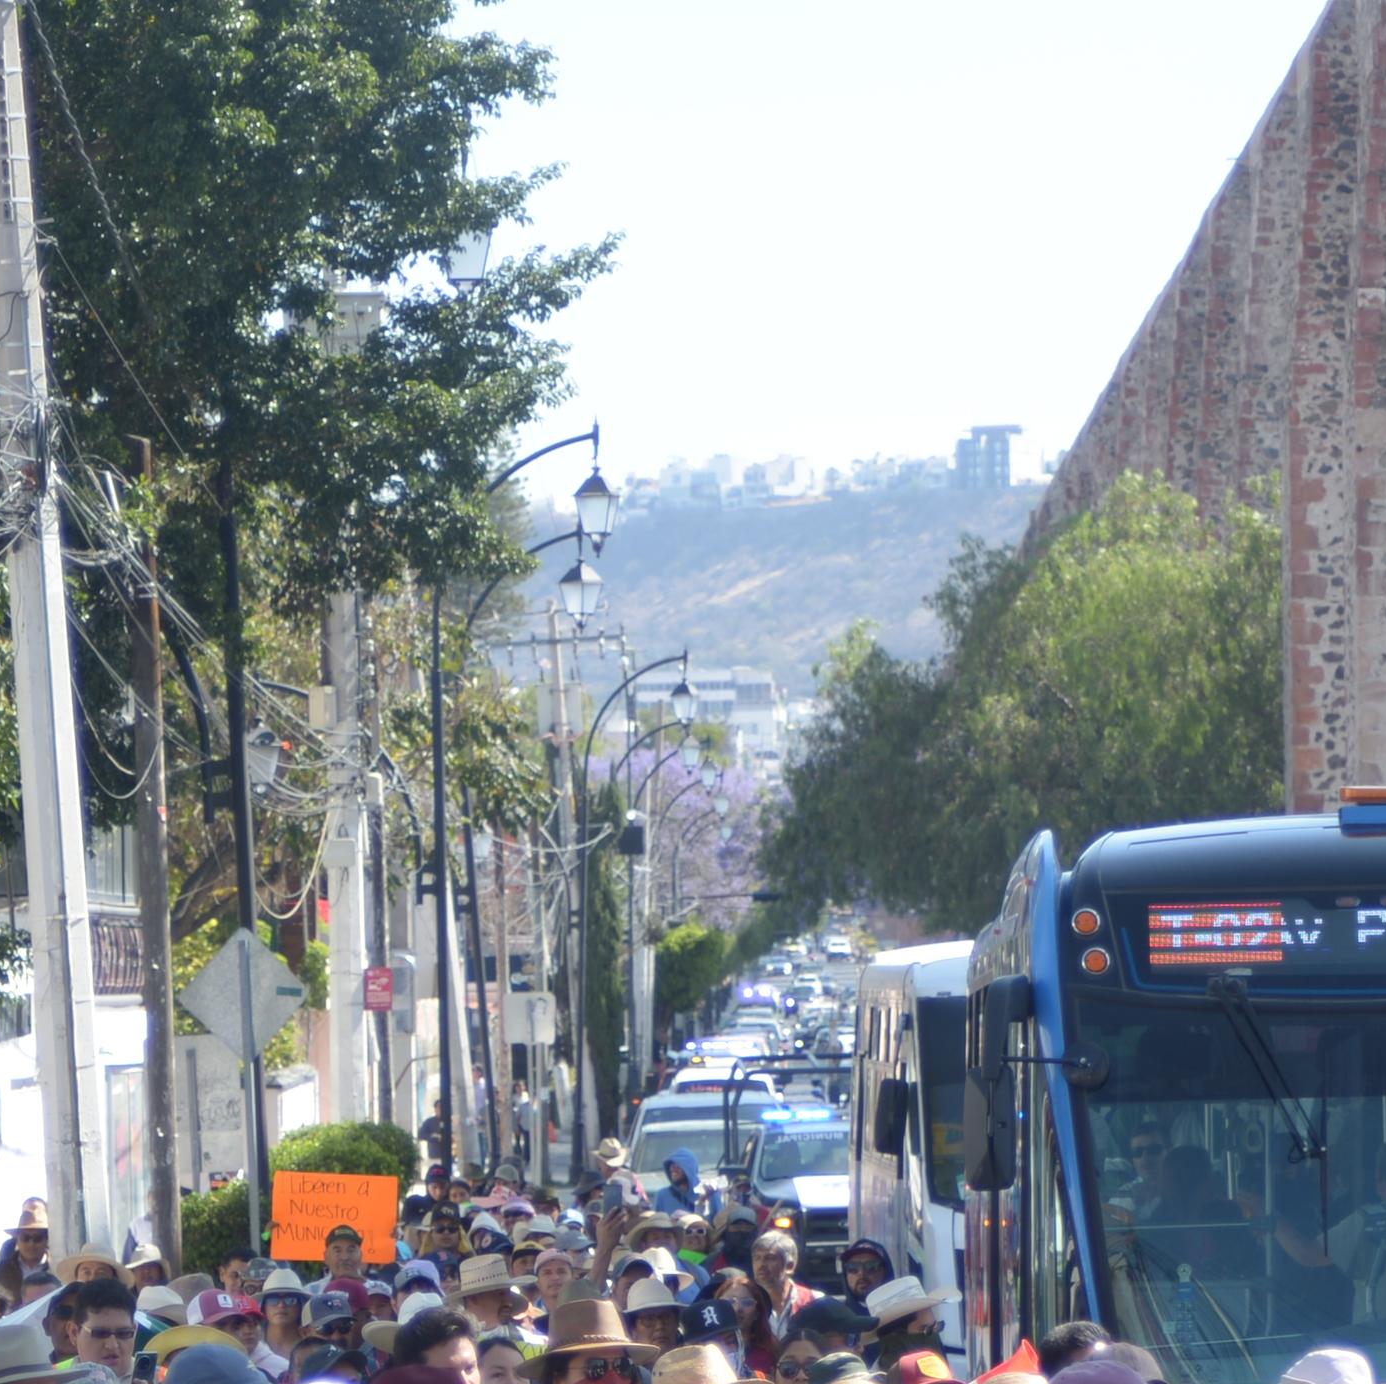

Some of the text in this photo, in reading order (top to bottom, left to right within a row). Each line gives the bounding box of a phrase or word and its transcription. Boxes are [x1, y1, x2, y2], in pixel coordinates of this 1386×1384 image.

[290, 1175, 370, 1197] Liberen a
[289, 1198, 359, 1222] Nuestro
